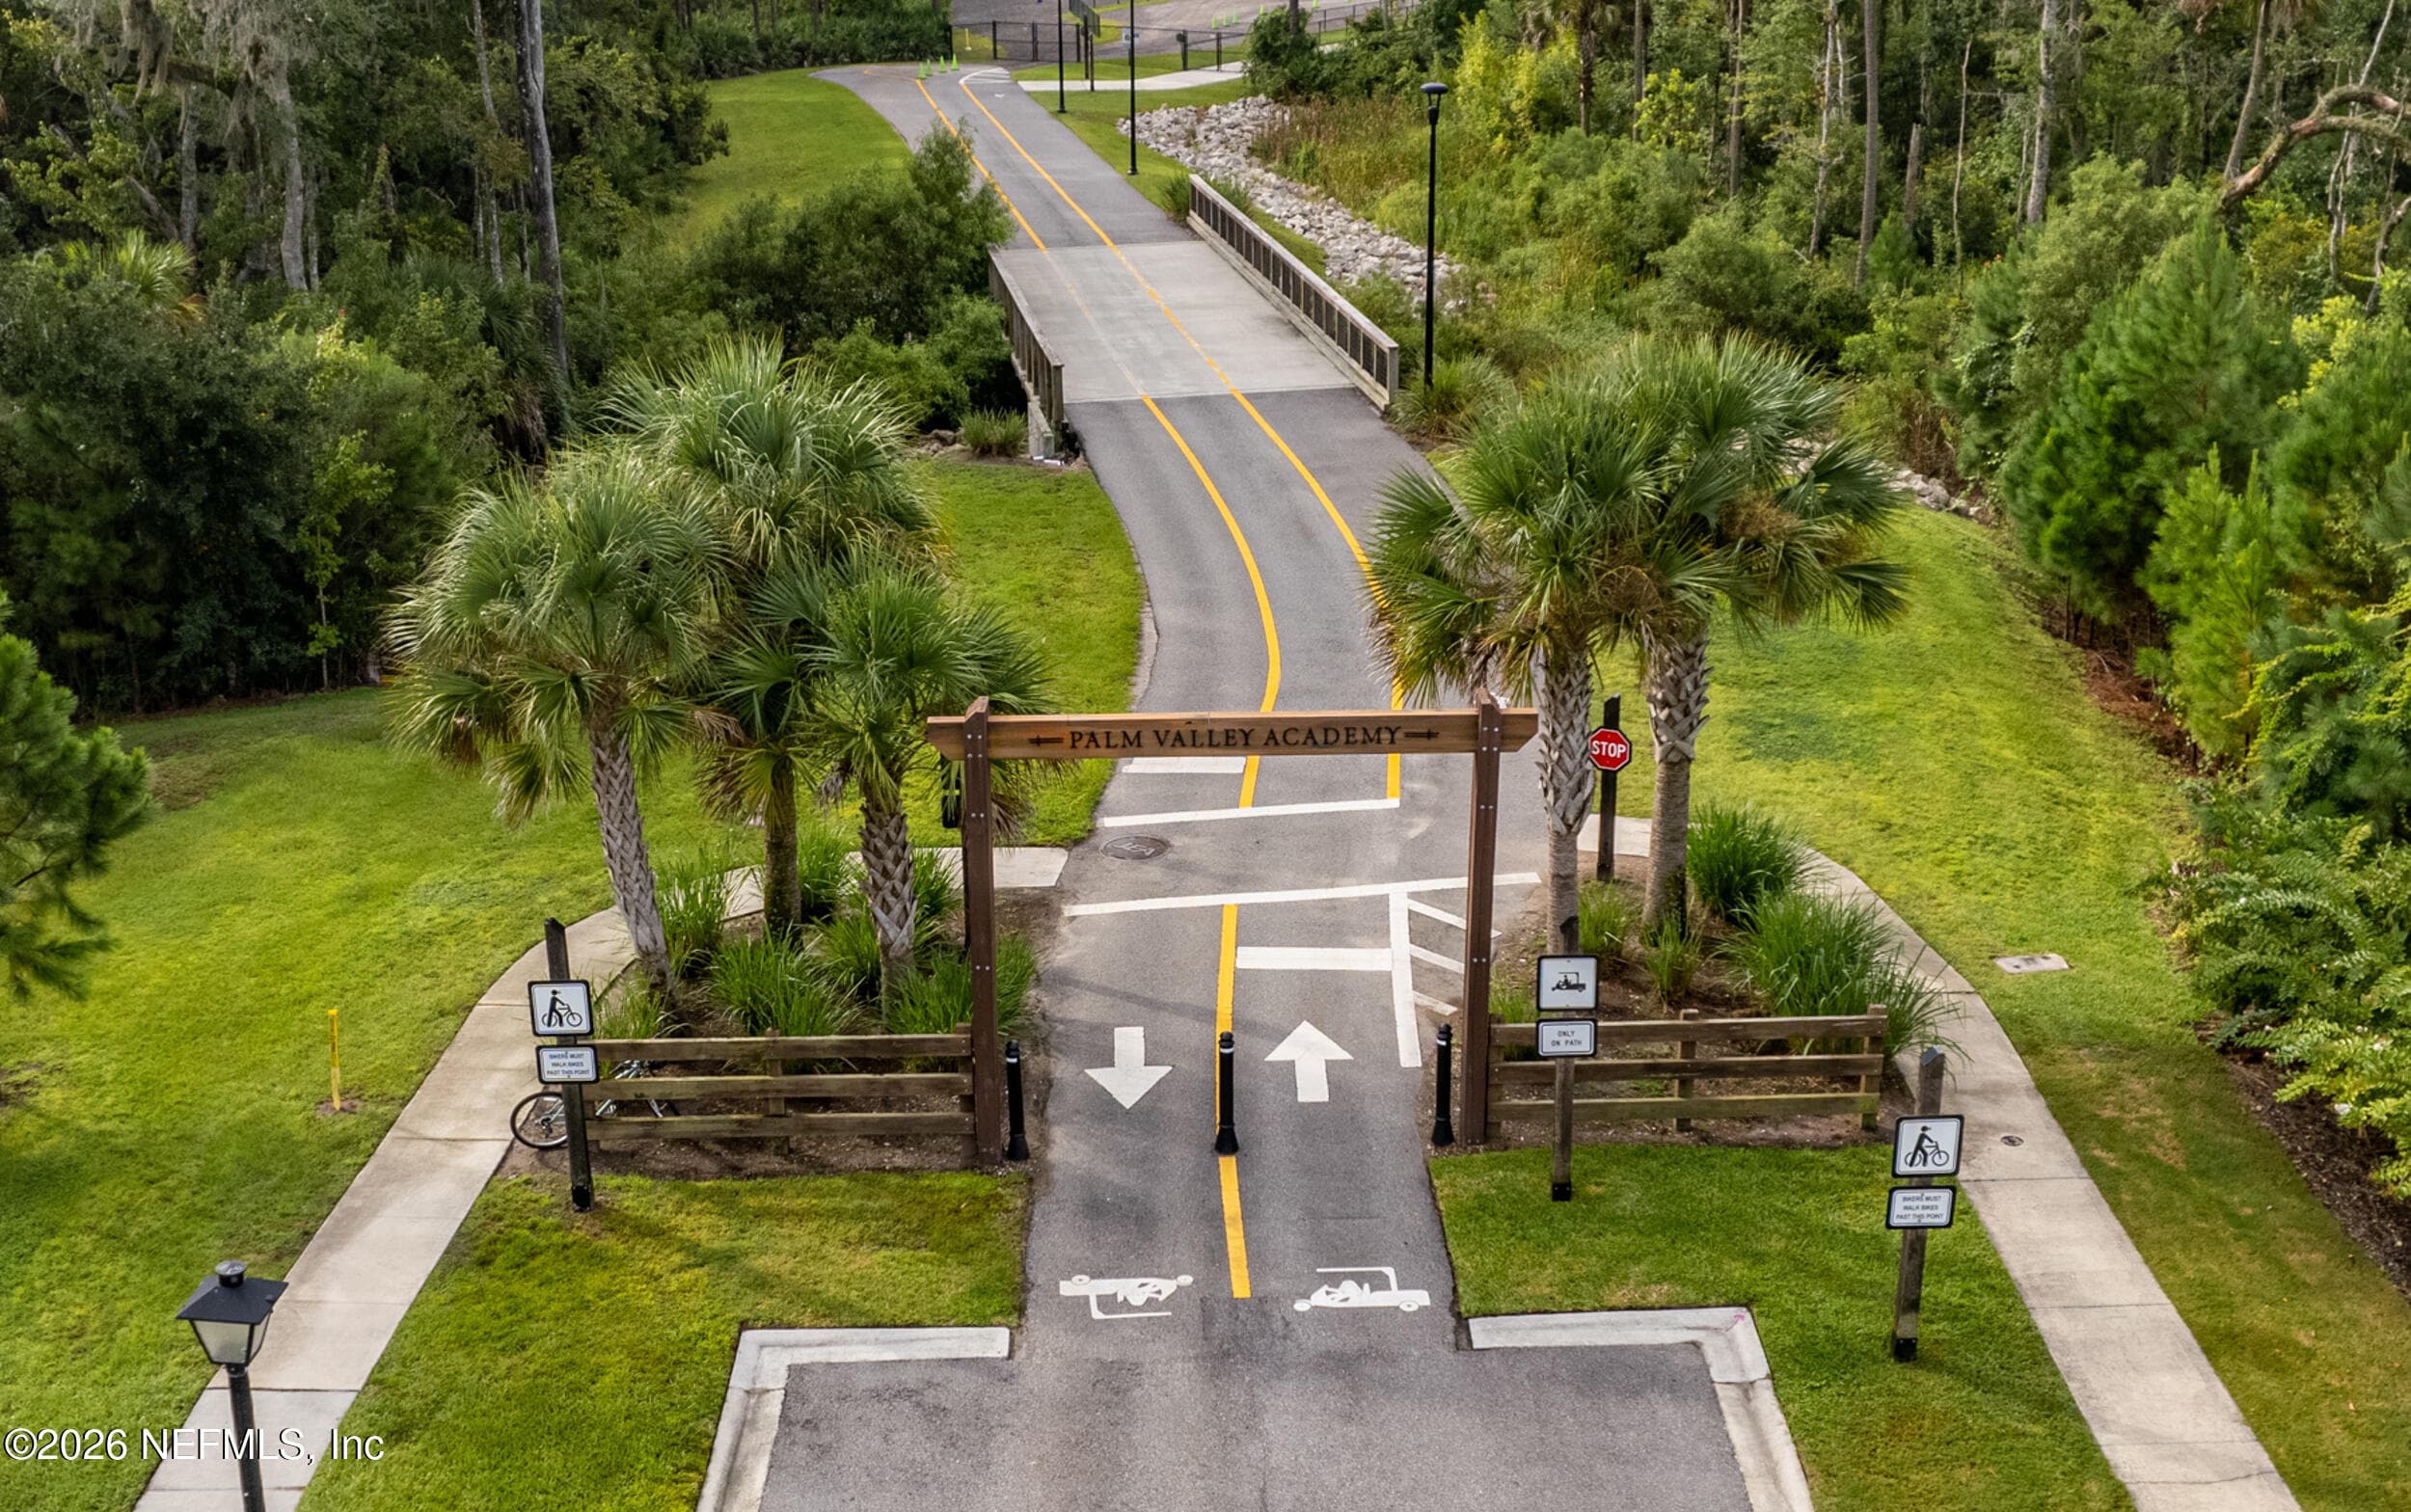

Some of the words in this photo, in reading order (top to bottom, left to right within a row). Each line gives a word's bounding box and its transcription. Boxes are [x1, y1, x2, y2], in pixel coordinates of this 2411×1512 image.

[1069, 730, 1143, 748] PALM
[1152, 728, 1256, 747] VALLEY
[1262, 726, 1401, 746] ACADEMY
[1591, 740, 1627, 759] STOP
